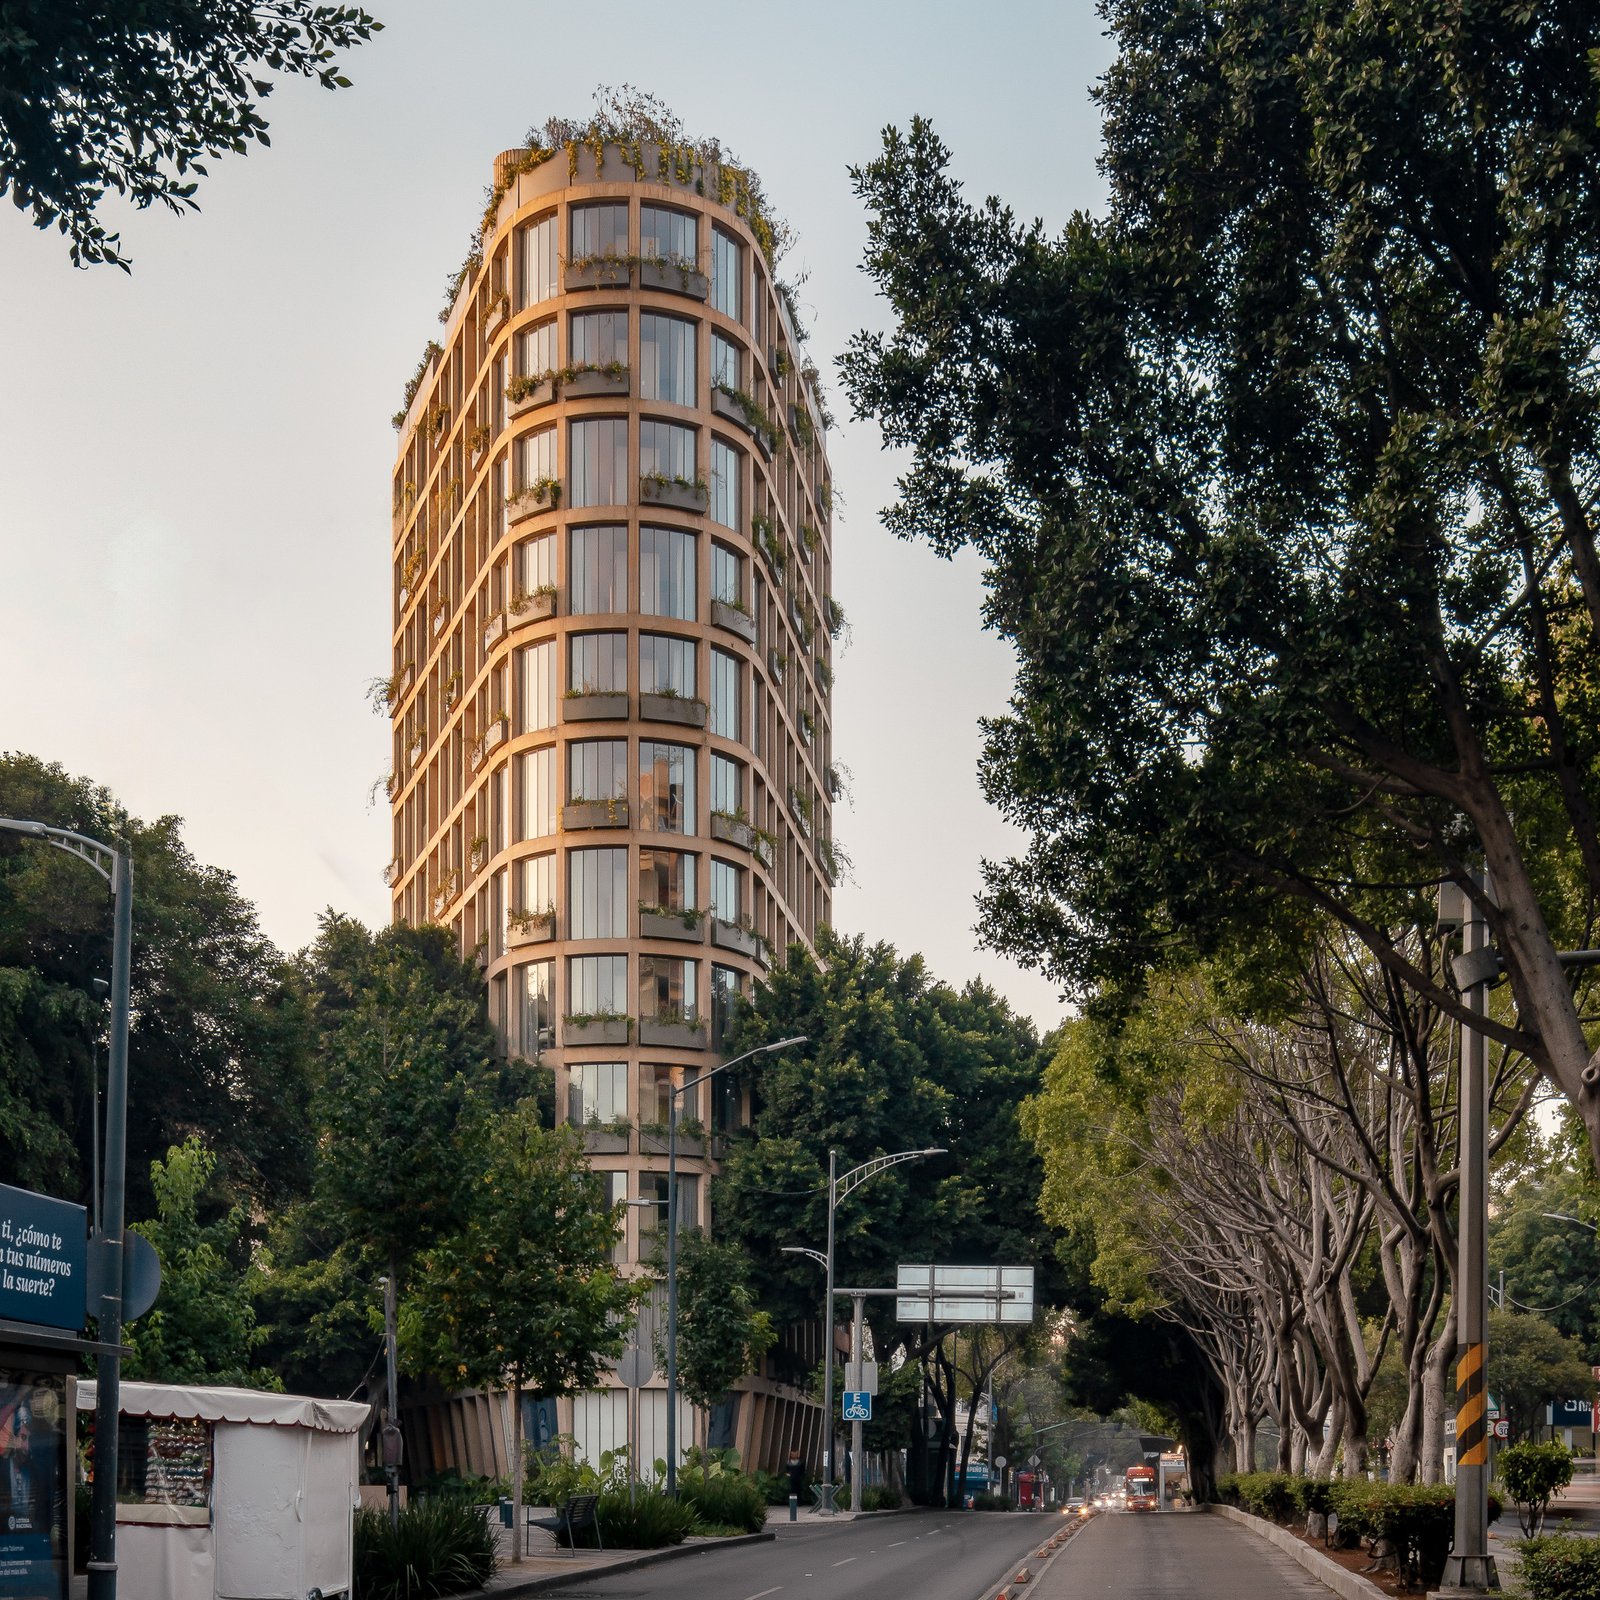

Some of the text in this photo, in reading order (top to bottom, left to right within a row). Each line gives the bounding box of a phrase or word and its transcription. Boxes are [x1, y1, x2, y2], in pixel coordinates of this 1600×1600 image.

[2, 1219, 62, 1250] ti, ¿cómo te
[6, 1247, 24, 1267] tus
[26, 1250, 72, 1277] números
[2, 1269, 55, 1297] la suerte?
[853, 1393, 861, 1403] E
